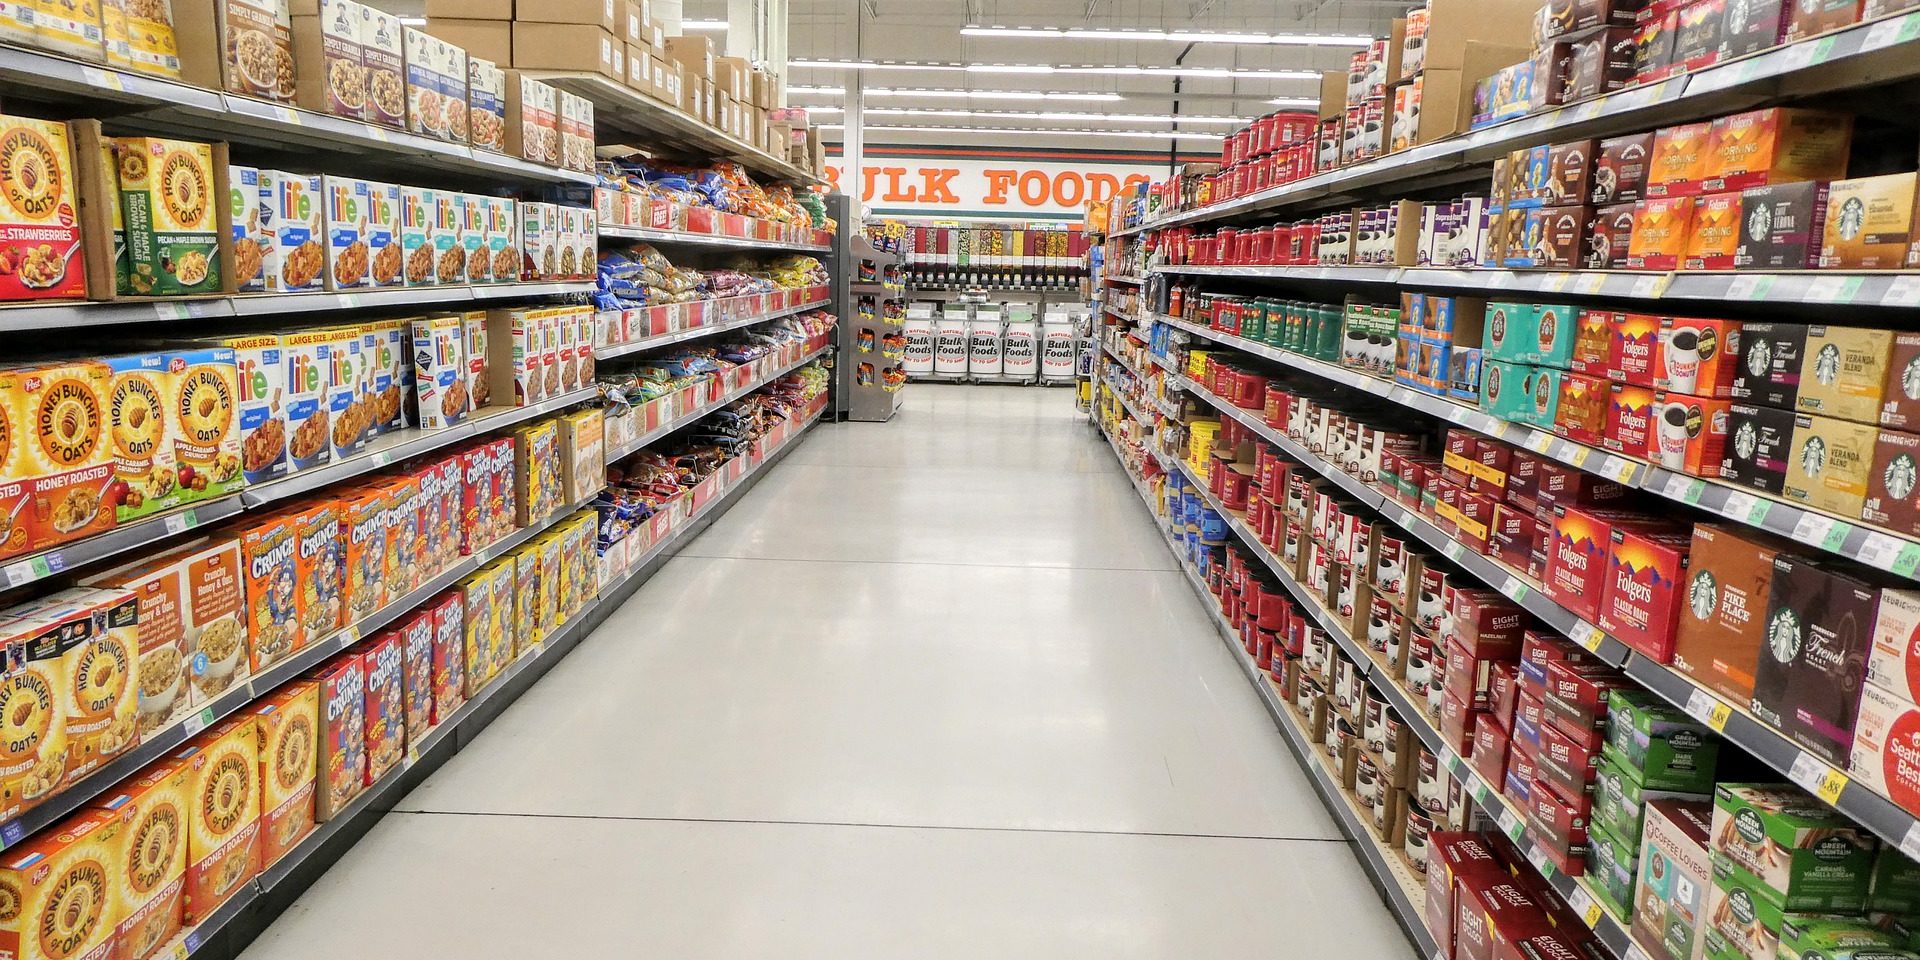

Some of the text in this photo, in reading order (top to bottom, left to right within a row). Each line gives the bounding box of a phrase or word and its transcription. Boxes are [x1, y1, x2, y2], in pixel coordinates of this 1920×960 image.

[1, 132, 58, 186] HONEY BUNCHES
[165, 158, 178, 197] HONEY
[178, 155, 205, 199] BUNCHES
[24, 191, 55, 214] OATS
[279, 180, 311, 221] life
[330, 186, 357, 223] life
[367, 190, 391, 226] life
[181, 204, 202, 223] OATS
[403, 195, 425, 228] life
[436, 198, 456, 230] life
[463, 201, 481, 230] life
[488, 203, 507, 232] life
[8, 228, 72, 241] STRAWBERRIES
[129, 194, 142, 260] BROWN SUGAR
[138, 193, 146, 223] PECAN
[142, 231, 151, 261] MAPLE
[231, 337, 276, 350] LARGE SIZE
[289, 334, 327, 345] LARGE SIZE
[907, 337, 929, 345] Bulk
[940, 337, 963, 345] Bulk
[972, 337, 995, 346] Bulk
[1007, 339, 1030, 348] Bulk
[1047, 340, 1071, 349] Bulk
[214, 350, 233, 361] New!
[435, 334, 455, 366] life
[903, 345, 931, 354] Foods
[937, 345, 965, 354] Foods
[970, 347, 998, 355] Foods
[1005, 348, 1032, 356] Foods
[1045, 349, 1073, 358] Foods
[1623, 341, 1649, 358] Folgers
[1773, 349, 1796, 360] French
[141, 355, 161, 367] New!
[171, 360, 185, 372] Post
[330, 349, 352, 387] life
[1622, 357, 1647, 368] CLASSIC ROAST
[1844, 363, 1862, 372] BLEND
[1846, 353, 1876, 366] VERANDA
[289, 354, 319, 394] life
[1675, 370, 1695, 378] DONUTS
[25, 379, 41, 390] Post
[112, 379, 161, 427] HONEY BUNCHES
[182, 372, 229, 417] HONEY BUNCHES
[1798, 396, 1805, 406] 10
[42, 384, 97, 436] HONEY BUNCHES
[1620, 411, 1646, 429] Folgers
[197, 426, 220, 442] OATS
[1618, 427, 1645, 439] CLASSIC ROAST
[1758, 432, 1780, 446] French
[62, 436, 93, 462] OATS
[129, 438, 153, 454] OATS
[175, 442, 216, 453] APPLE CARAMEL
[183, 451, 208, 459] CRUNCH
[1831, 449, 1860, 462] VERANDA
[1829, 457, 1847, 468] BLEND
[36, 466, 109, 492] HONEY ROASTED
[1592, 483, 1623, 494] EIGHT
[351, 508, 387, 545] CRUNCH
[1693, 527, 1714, 541] KEURIG
[300, 520, 338, 560] CRUNCH
[251, 536, 295, 579] CRUNCH
[1558, 541, 1587, 570] Folgers
[1775, 559, 1792, 570] KEURIG
[204, 566, 227, 583] Crunchy
[1555, 566, 1585, 589] CLASSIC ROAST
[198, 574, 234, 596] Honey & Oats
[1616, 569, 1651, 603] Folgers
[1723, 590, 1746, 609] PIKE
[1614, 596, 1649, 623] CLASSIC ROAST
[1720, 613, 1741, 625] ROAST
[1721, 602, 1750, 622] PLACE
[1492, 614, 1519, 625] EIGHT
[1493, 622, 1519, 630] O'CLOCK
[1811, 623, 1837, 638] STARBUCKS
[1532, 648, 1547, 659] EIGHT
[1805, 632, 1844, 666] French
[78, 650, 96, 691] HONEY
[98, 640, 125, 673] BUNCHES
[1674, 653, 1683, 668] 32
[1806, 652, 1827, 666] ROAST
[336, 664, 356, 694] CAP'N
[369, 647, 402, 692] CRUNCH
[327, 671, 364, 721] CRUNCH
[1559, 680, 1578, 693] EIGHT
[1559, 690, 1577, 700] O'CLOCK
[91, 692, 115, 711] OATS
[1751, 698, 1762, 716] 32
[1707, 705, 1725, 723] 18.88
[10, 731, 38, 752] OATS
[1891, 738, 1920, 767] Seatt
[206, 758, 247, 816] HONEY BUNCHES
[1815, 771, 1840, 796] 18.88
[221, 798, 244, 831] OATS
[1740, 813, 1759, 829] GREEN
[1736, 819, 1763, 839] MOUNTAIN
[201, 822, 255, 871] HONEY ROASTED
[1456, 840, 1481, 860] O'CLOCK
[1464, 840, 1492, 859] EIGHT
[1654, 827, 1708, 881] COFFEE LOVERS
[45, 867, 102, 937] HONEY BUNCHES
[1492, 885, 1521, 907] O'CLOCK
[1499, 884, 1533, 907] EIGHT
[122, 880, 179, 933] HONEY ROASTED
[1462, 905, 1482, 934] EIGHT
[63, 915, 95, 954] OATS
[1462, 922, 1483, 946] O'CLOCK
